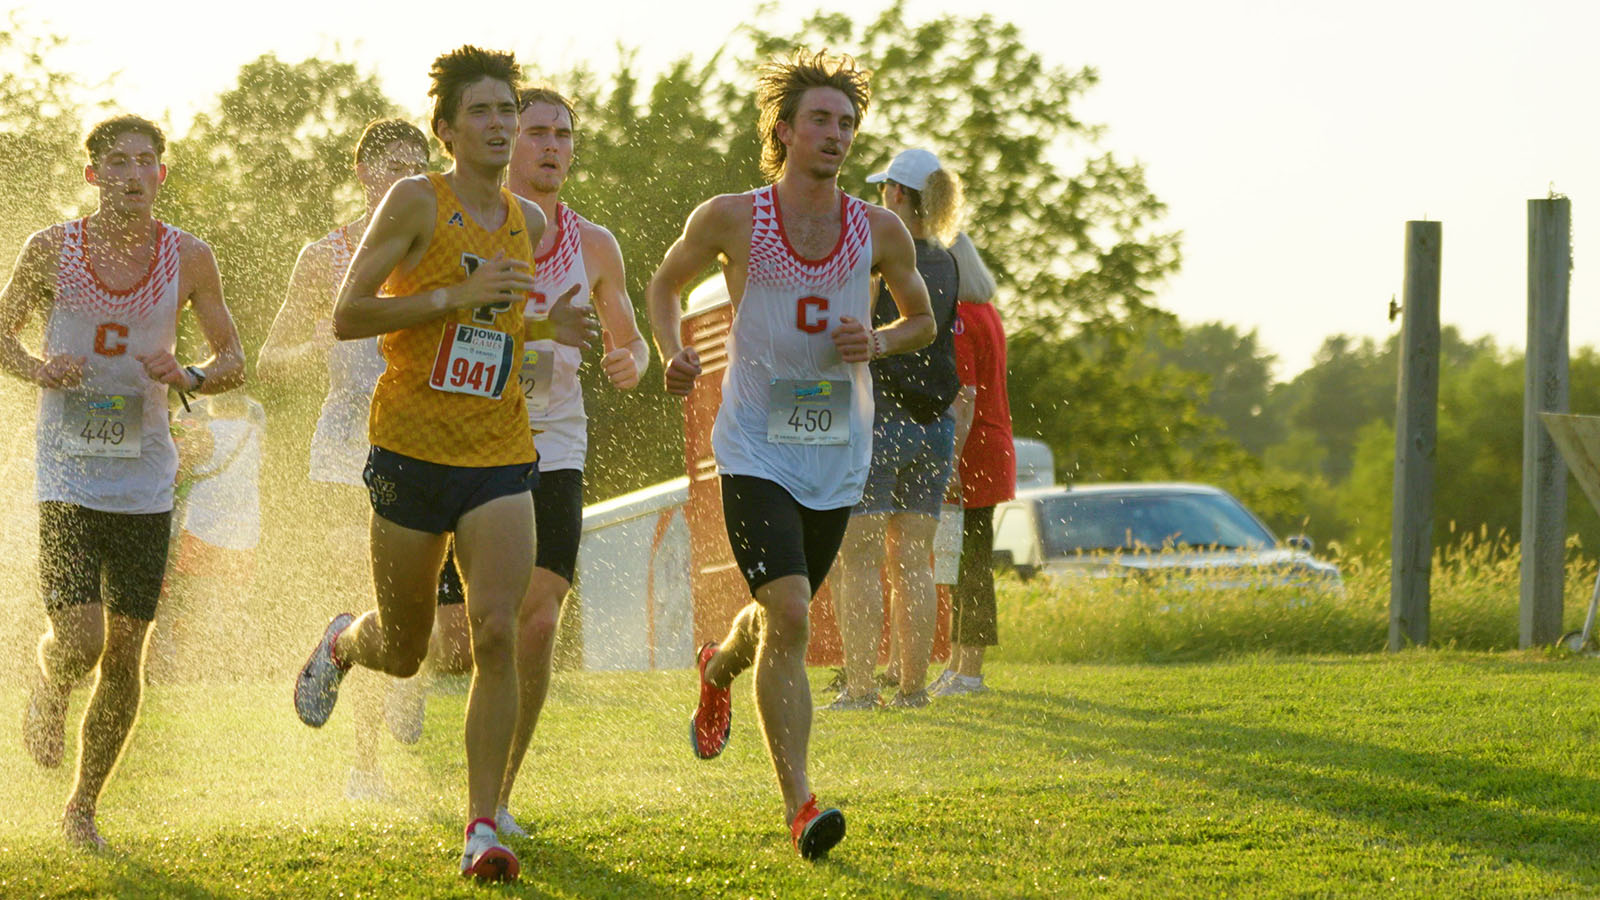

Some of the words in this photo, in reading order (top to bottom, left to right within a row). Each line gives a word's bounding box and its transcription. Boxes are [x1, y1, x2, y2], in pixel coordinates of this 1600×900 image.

[796, 296, 829, 334] C
[94, 322, 129, 357] C
[472, 339, 502, 350] GAMES
[474, 329, 502, 342] IOWA
[450, 357, 496, 393] 941
[787, 406, 832, 432] 450
[80, 420, 125, 445] 449
